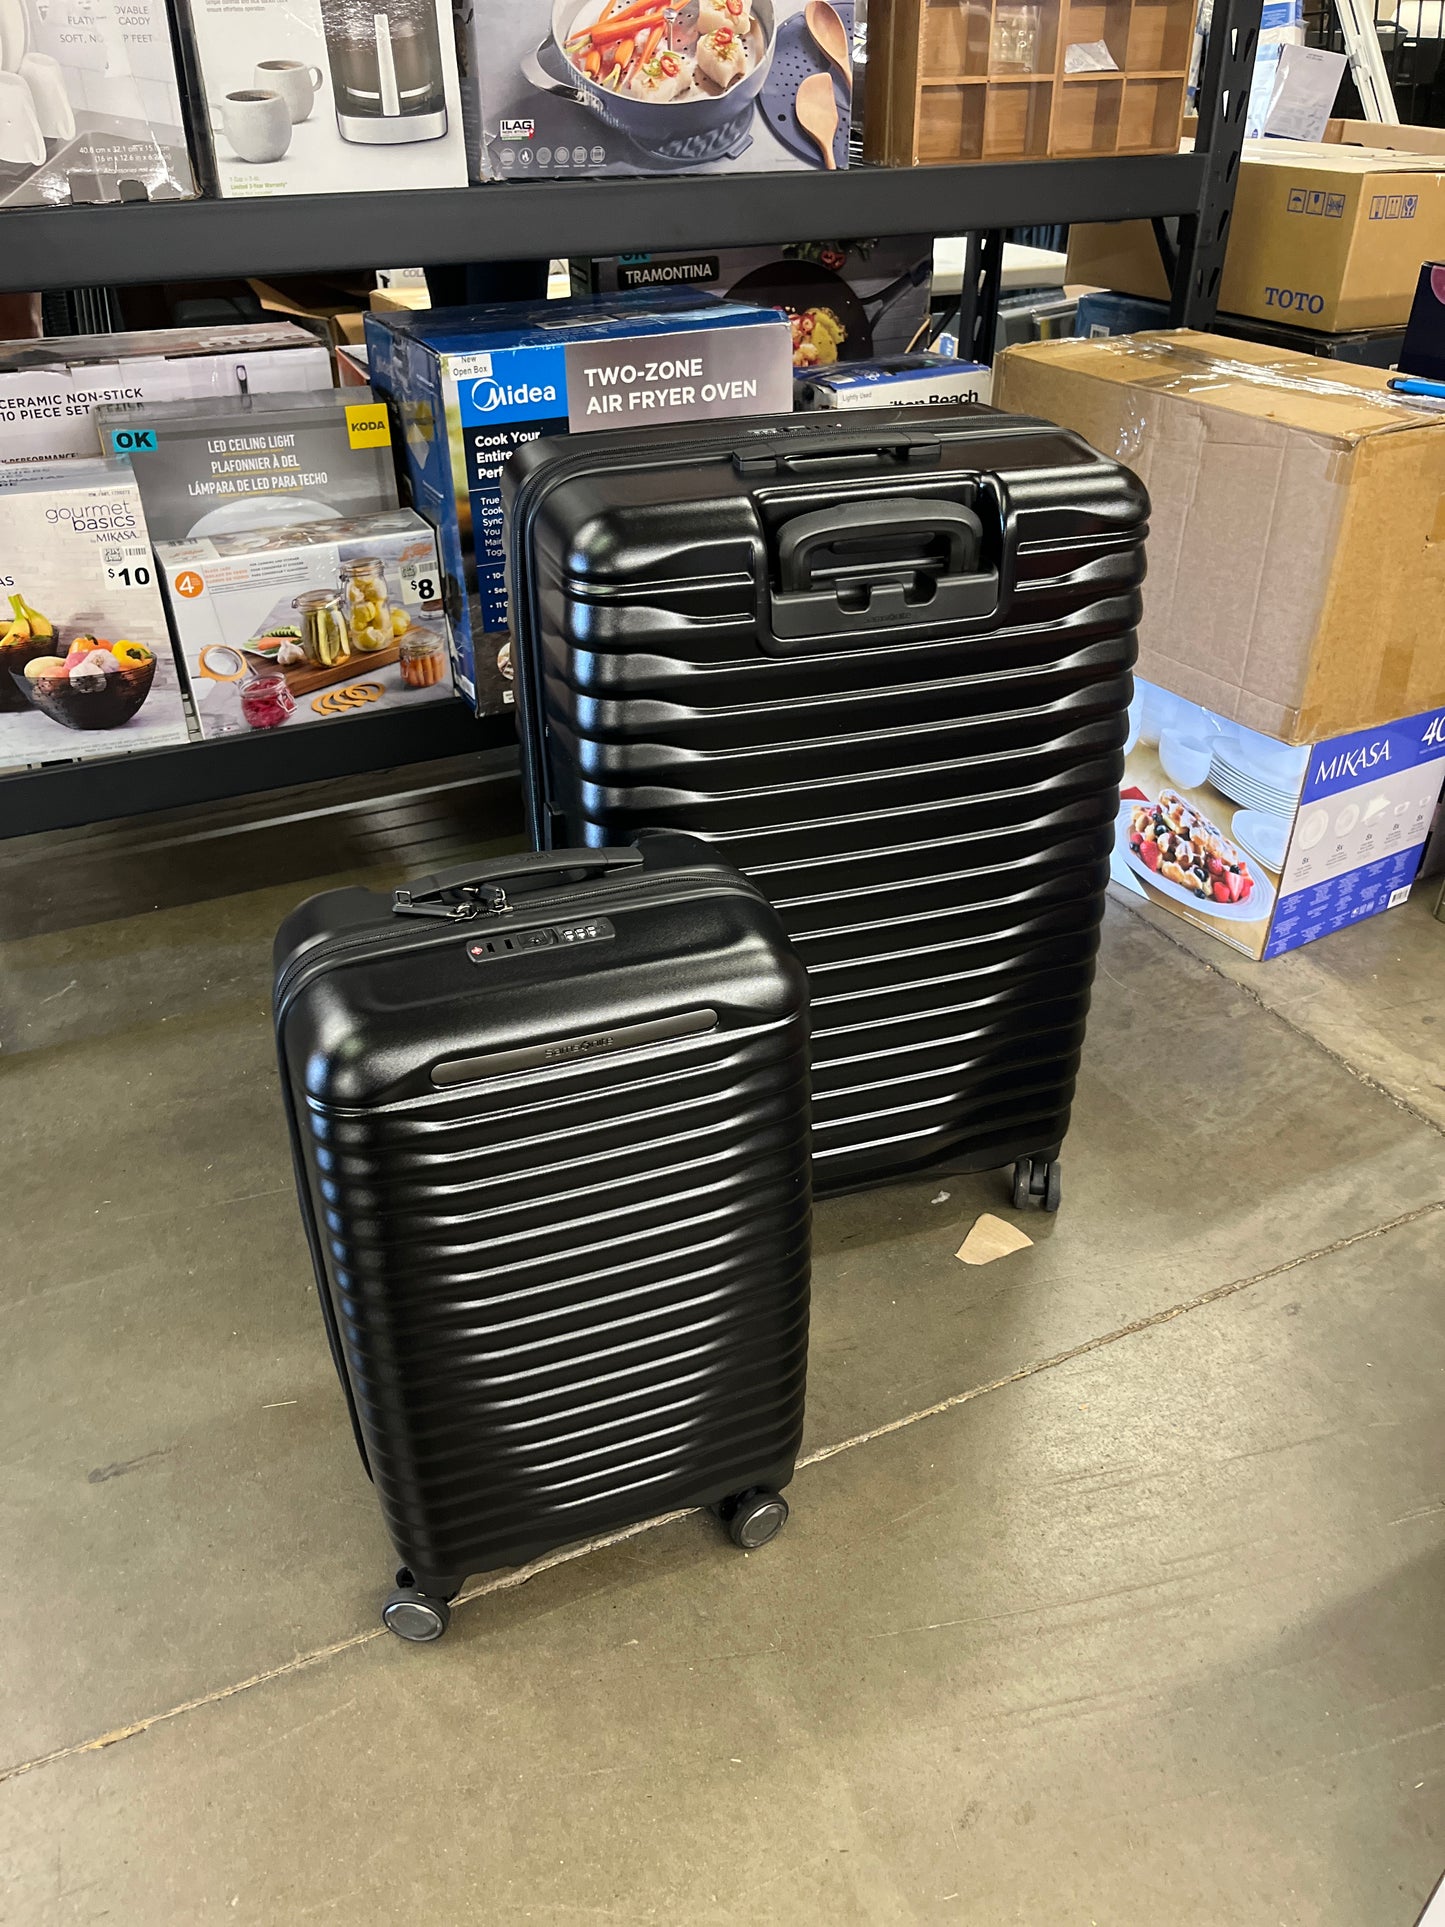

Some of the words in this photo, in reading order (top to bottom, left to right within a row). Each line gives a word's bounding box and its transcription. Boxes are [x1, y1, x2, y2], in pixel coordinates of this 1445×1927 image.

[119, 16, 151, 25] CADDY
[59, 34, 87, 44] SOFT,
[131, 34, 153, 43] FEET
[502, 120, 532, 130] ILAG
[625, 263, 713, 284] TRAMONTINA
[1265, 287, 1324, 314] TOTO
[453, 367, 472, 377] Open
[473, 365, 488, 374] Box
[584, 359, 703, 387] TWO-ZONE
[66, 388, 144, 404] NON-STICK
[475, 379, 557, 410] Midea
[586, 394, 623, 416] AIR
[628, 386, 696, 412] FRYER
[700, 379, 758, 402] OVEN
[842, 393, 859, 402] Lightly
[1, 411, 16, 422] 10
[21, 407, 62, 420] PIECE
[66, 404, 91, 416] SET
[351, 420, 386, 432] KODA
[116, 432, 153, 449] OK
[208, 439, 227, 454] LED
[228, 436, 267, 451] CEILING
[268, 434, 296, 449] LIGHT
[474, 432, 509, 447] Cook
[510, 431, 541, 444] Your
[211, 457, 271, 473] PLAFONNIER
[272, 452, 281, 470] À
[281, 454, 300, 468] DEL
[476, 449, 513, 464] Entire
[188, 480, 236, 496] LÁMPARA
[237, 478, 250, 493] DE
[251, 477, 270, 492] LED
[272, 474, 297, 489] PARA
[298, 472, 328, 487] TECHO
[480, 497, 500, 505] True
[45, 501, 131, 524] gourmet
[73, 513, 136, 531] basics
[96, 530, 138, 544] MIKASA
[108, 566, 150, 586] $10
[179, 575, 195, 594] 4
[411, 578, 435, 600] $8
[1314, 739, 1391, 785] MIKASA
